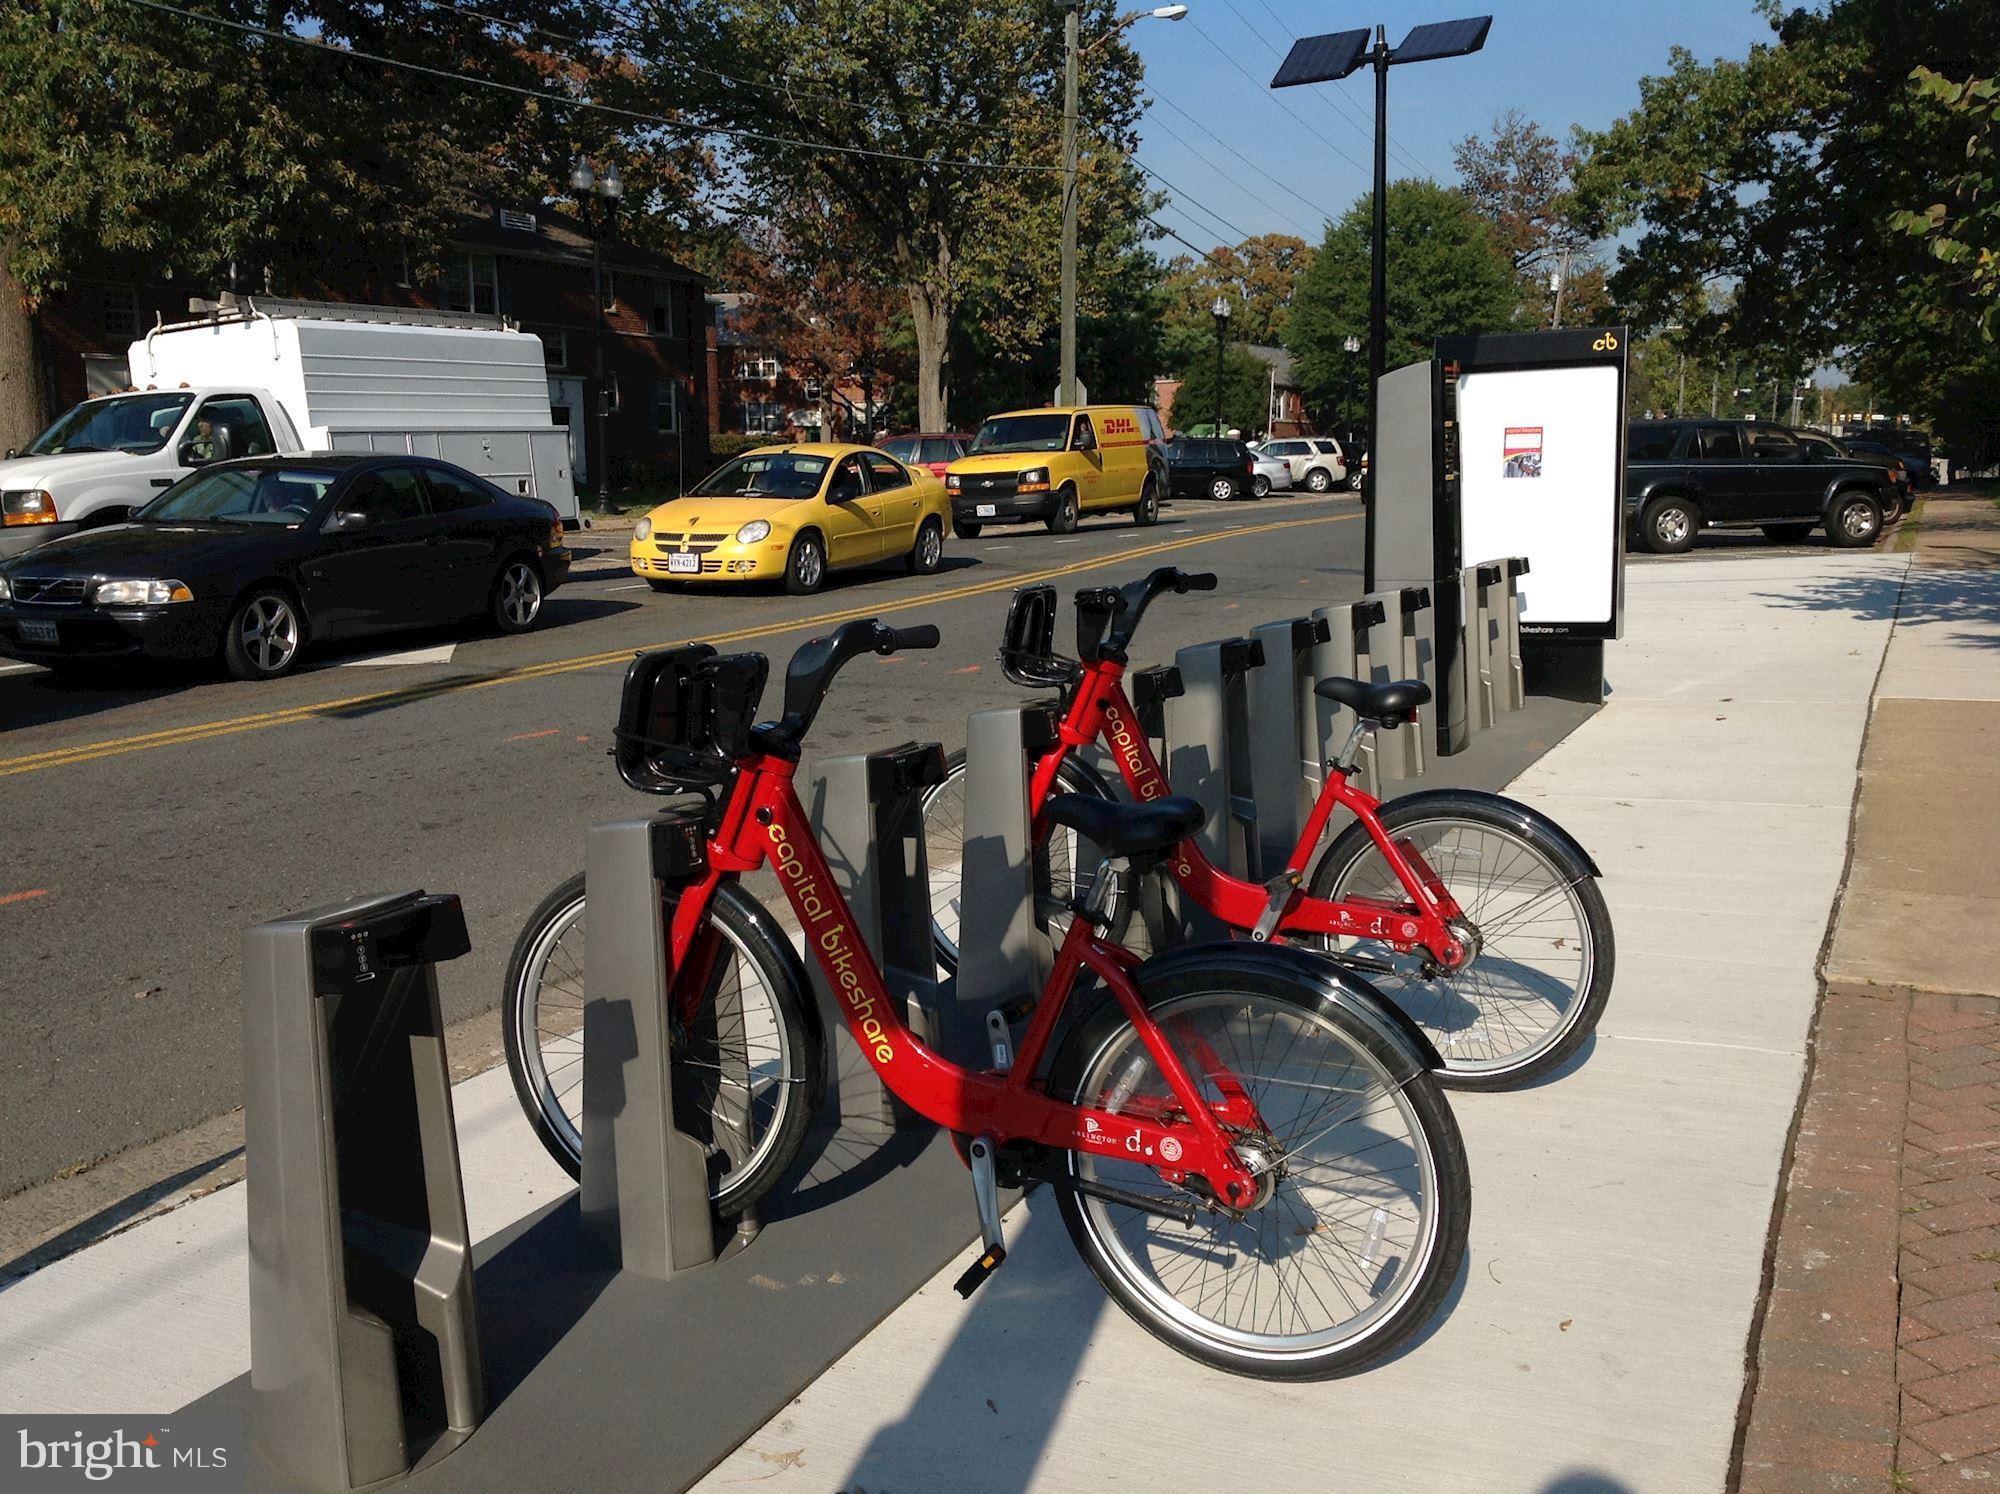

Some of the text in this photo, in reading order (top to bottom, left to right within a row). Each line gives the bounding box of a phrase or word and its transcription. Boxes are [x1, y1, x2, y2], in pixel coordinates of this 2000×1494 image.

[1103, 418, 1135, 434] DHL
[1106, 706, 1150, 778] capital
[768, 823, 894, 1064] capital bikeshare
